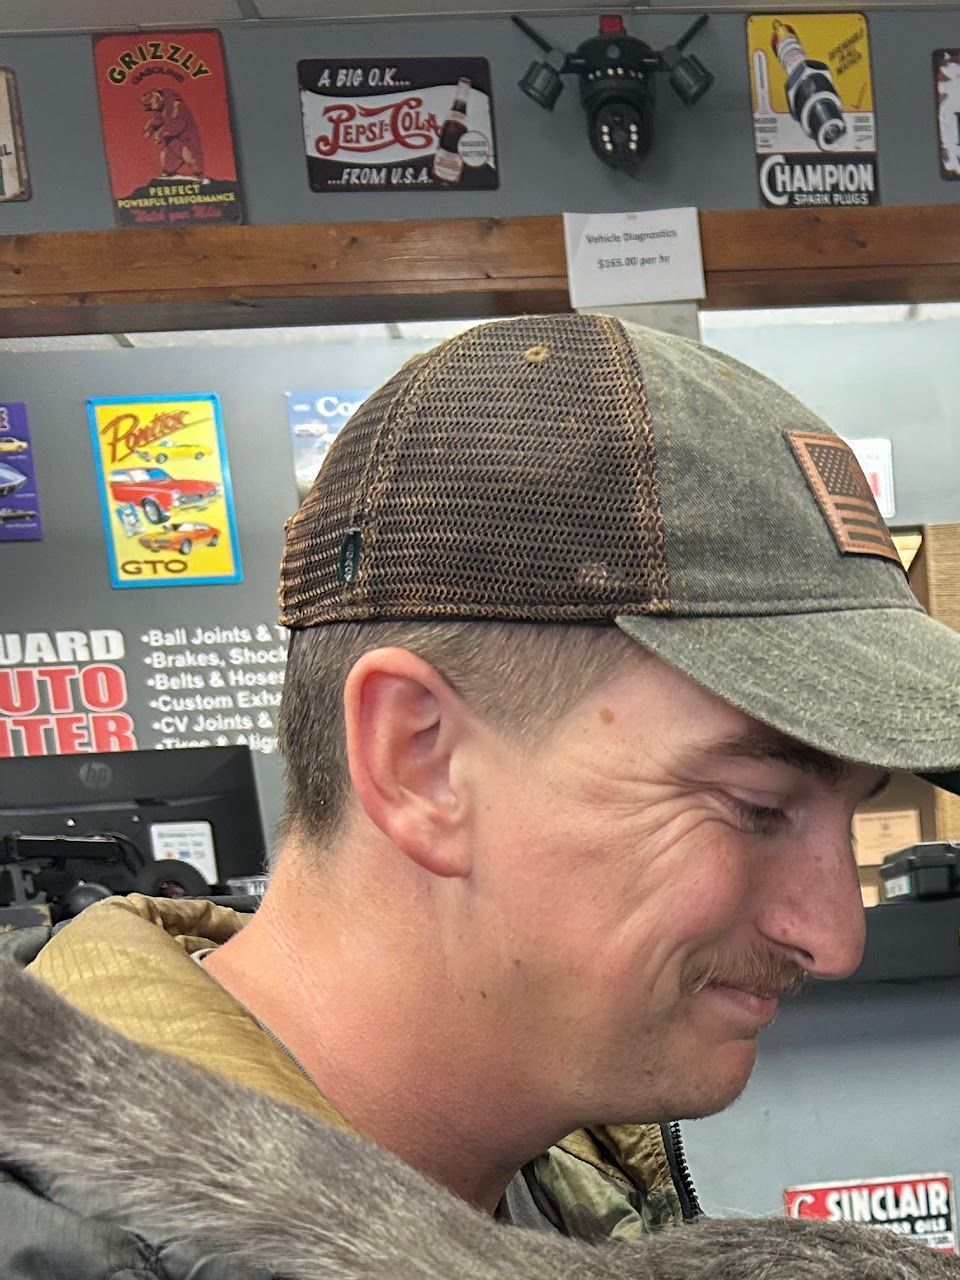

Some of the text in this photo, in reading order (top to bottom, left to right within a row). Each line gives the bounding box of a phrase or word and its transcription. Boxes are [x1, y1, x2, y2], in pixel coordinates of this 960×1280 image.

[107, 41, 212, 86] GRIZZLY
[318, 69, 331, 87] A
[336, 68, 363, 87] BIG
[391, 167, 433, 184] U.S.A.
[760, 154, 875, 206] CHAMPION
[149, 184, 200, 196] PERFECT
[794, 193, 870, 205] SPARK PLUGS
[118, 192, 236, 209] POWERFUL PERFORMANCE
[585, 230, 677, 244] Vehicle Diagnostics
[641, 257, 656, 268] per
[101, 408, 197, 464] Pontiac
[121, 559, 188, 575] GTO
[149, 627, 188, 646] Ball
[190, 625, 252, 645] Joints
[255, 624, 273, 642] &
[151, 650, 227, 669] Brakes,
[155, 672, 206, 690] Belts
[209, 670, 226, 688] &
[0, 663, 129, 717] UTO
[158, 693, 234, 712] Custom
[160, 710, 273, 734] CV Joints &
[826, 1180, 949, 1222] SINCLAIR
